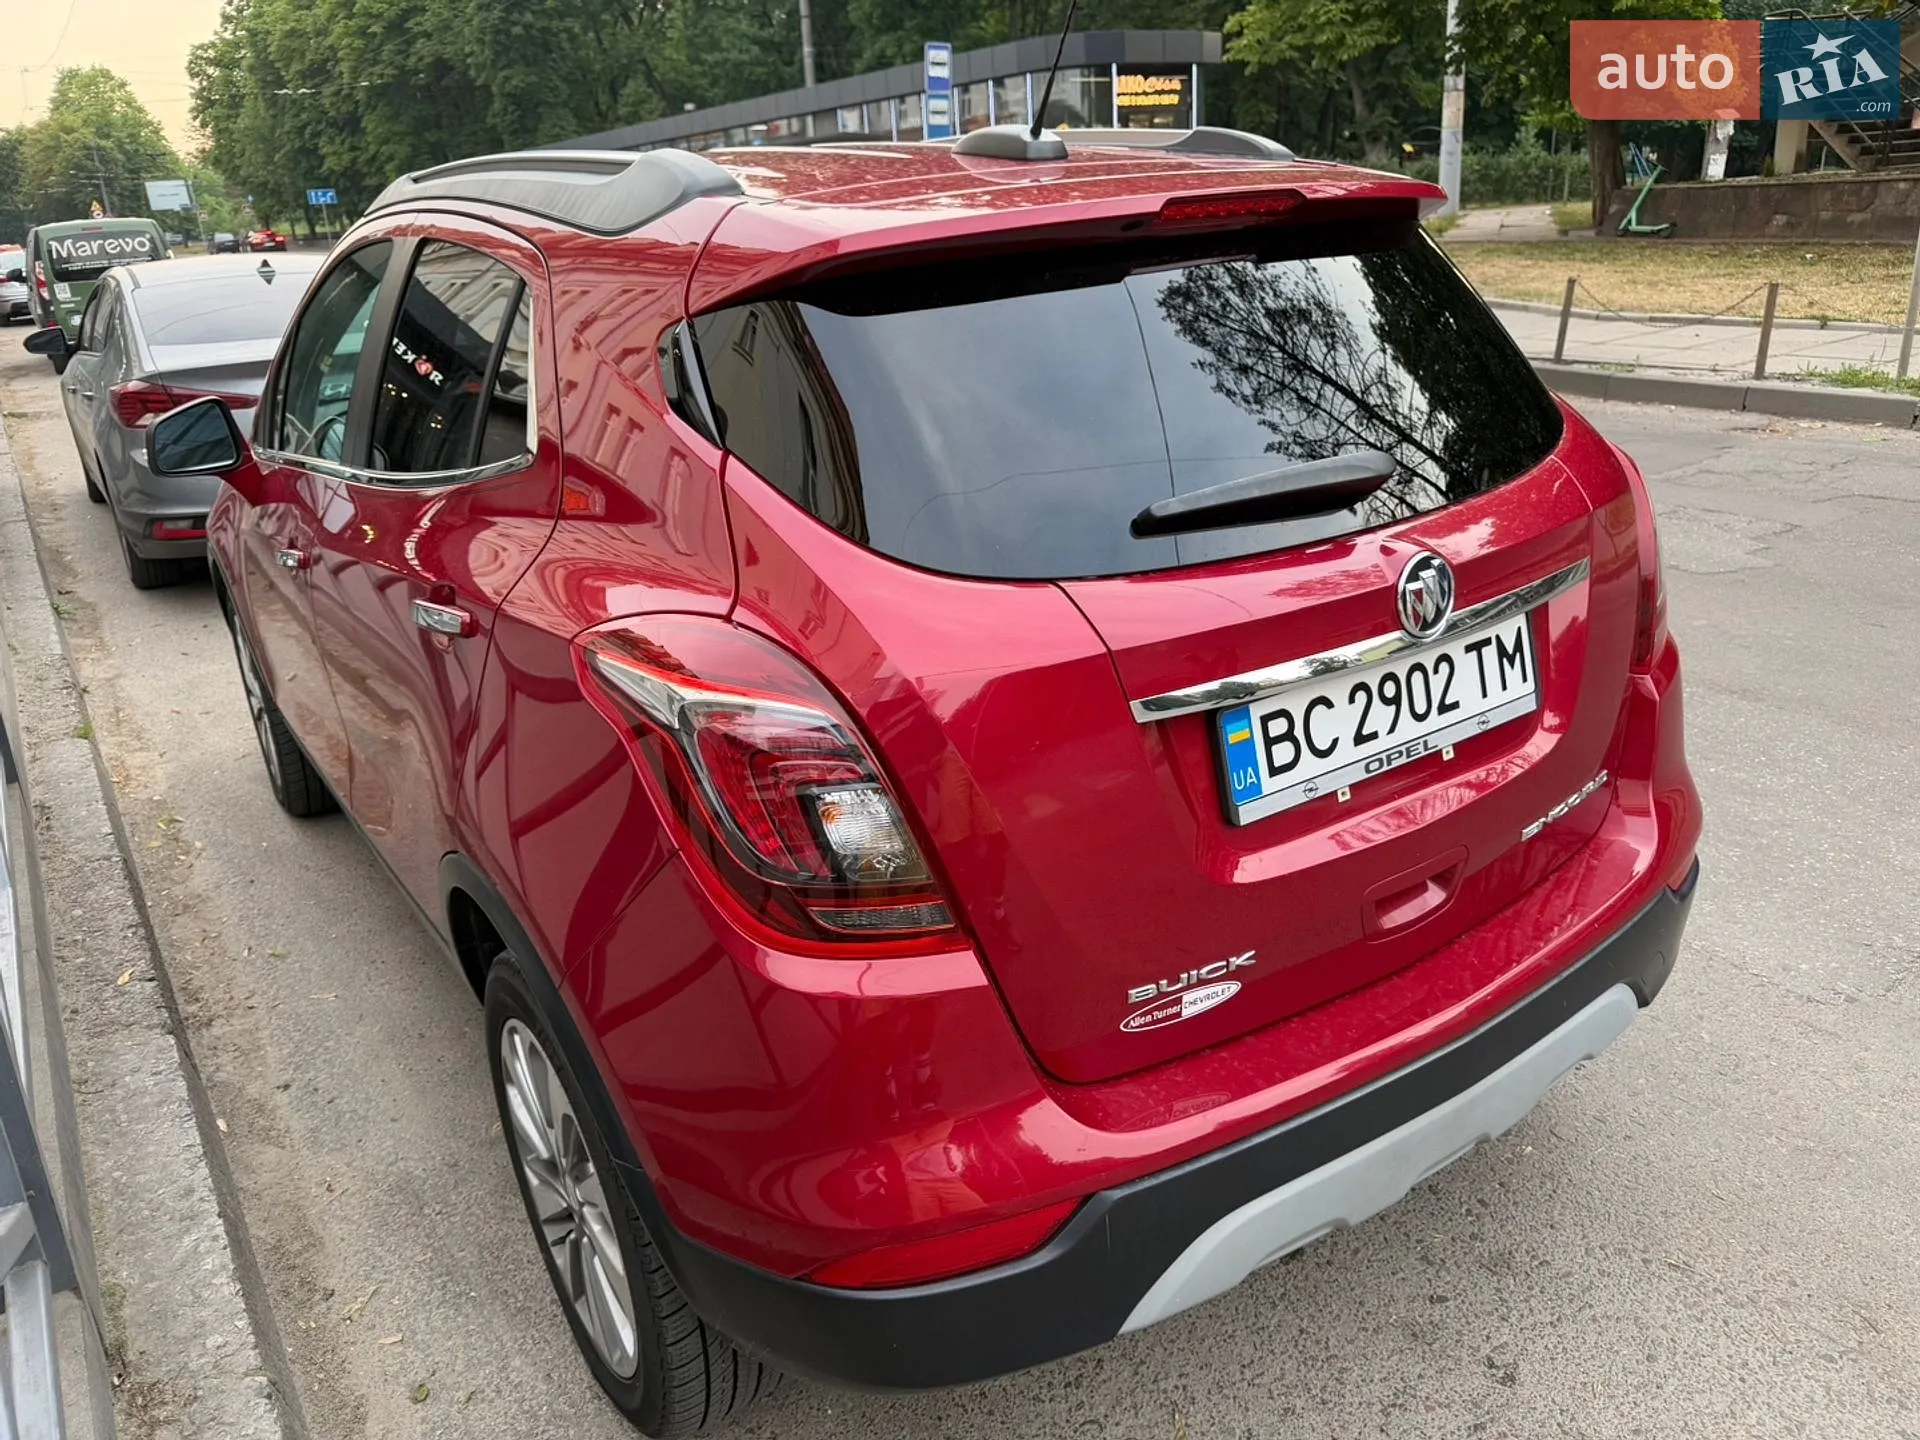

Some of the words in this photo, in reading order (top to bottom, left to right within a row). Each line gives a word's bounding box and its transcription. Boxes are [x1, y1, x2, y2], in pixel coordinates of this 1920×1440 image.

[49, 236, 150, 259] Marevo
[1260, 695, 1339, 777] BC
[1348, 652, 1460, 747] 2902
[1465, 626, 1528, 698] TM
[1364, 738, 1438, 775] OPEL
[1232, 770, 1257, 791] UA
[1127, 950, 1257, 1004] BUICK
[1128, 1014, 1153, 1029] Allen
[1153, 1004, 1182, 1020] Turner
[1184, 986, 1232, 1009] CHEVROLET
